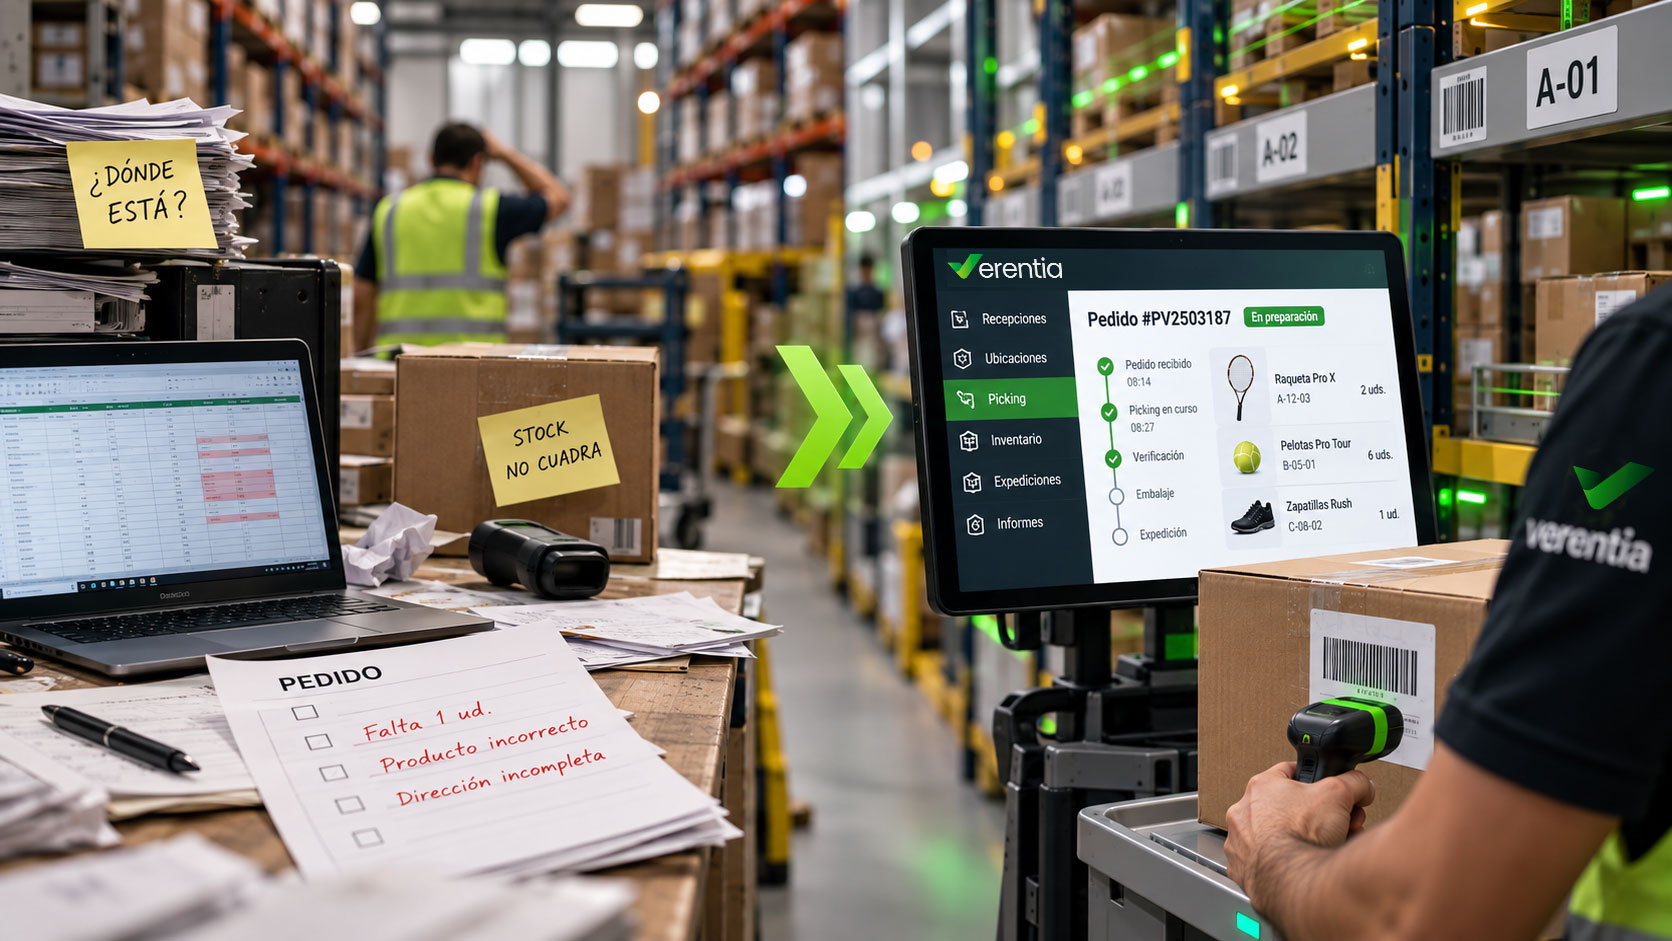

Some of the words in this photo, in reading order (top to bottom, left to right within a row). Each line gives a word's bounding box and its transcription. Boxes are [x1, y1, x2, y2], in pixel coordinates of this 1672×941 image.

[1536, 55, 1599, 108] A-01
[1262, 131, 1298, 167] A-02
[90, 158, 174, 198] ¿DÓNDE
[982, 312, 1047, 327] Recepciones
[1088, 311, 1138, 327] Pedido
[1142, 310, 1231, 326] #PV2503187
[1251, 311, 1263, 322] En
[1265, 310, 1318, 324] preparación
[985, 352, 1047, 365] Ubicaciones
[1125, 359, 1156, 370] Pedido
[1158, 358, 1192, 369] recibido
[1127, 377, 1151, 387] 08:14
[1275, 373, 1311, 387] Raqueta
[1312, 373, 1328, 384] Pro
[1329, 372, 1336, 383] X
[1361, 385, 1367, 395] 2
[1368, 384, 1386, 395] uds.
[988, 393, 1026, 407] Picking
[1277, 393, 1311, 404] A-12-03
[1129, 404, 1160, 417] Picking
[1162, 405, 1173, 414] en
[1174, 405, 1198, 414] curso
[513, 420, 569, 447] STOCK
[1131, 422, 1154, 432] 08:27
[991, 433, 1042, 446] Inventario
[1281, 440, 1314, 451] Pelotas
[1316, 439, 1330, 450] Pro
[1332, 438, 1351, 449] Tour
[506, 462, 529, 480] NO
[538, 441, 602, 471] CUADRA
[1133, 450, 1184, 462] Verificación
[1368, 450, 1374, 460] 6
[1375, 449, 1393, 460] uds.
[1283, 460, 1315, 471] B-05-01
[994, 474, 1061, 489] Expediciones
[1136, 488, 1175, 500] Embalaje
[1286, 499, 1329, 513] Zapatillas
[1331, 498, 1352, 509] Rush
[1379, 510, 1384, 520] 1
[1387, 508, 1400, 519] ud.
[997, 517, 1044, 529] Informes
[1288, 520, 1322, 532] C-08-02
[1140, 527, 1187, 541] Expedición
[279, 665, 383, 692] PEDIDO
[364, 716, 423, 743] Falta
[436, 710, 445, 726] 1
[458, 701, 492, 719] ud.
[380, 741, 477, 775] Producto
[489, 715, 589, 751] incorrecto
[397, 776, 491, 807] Dirección
[502, 749, 606, 783] incompleta
